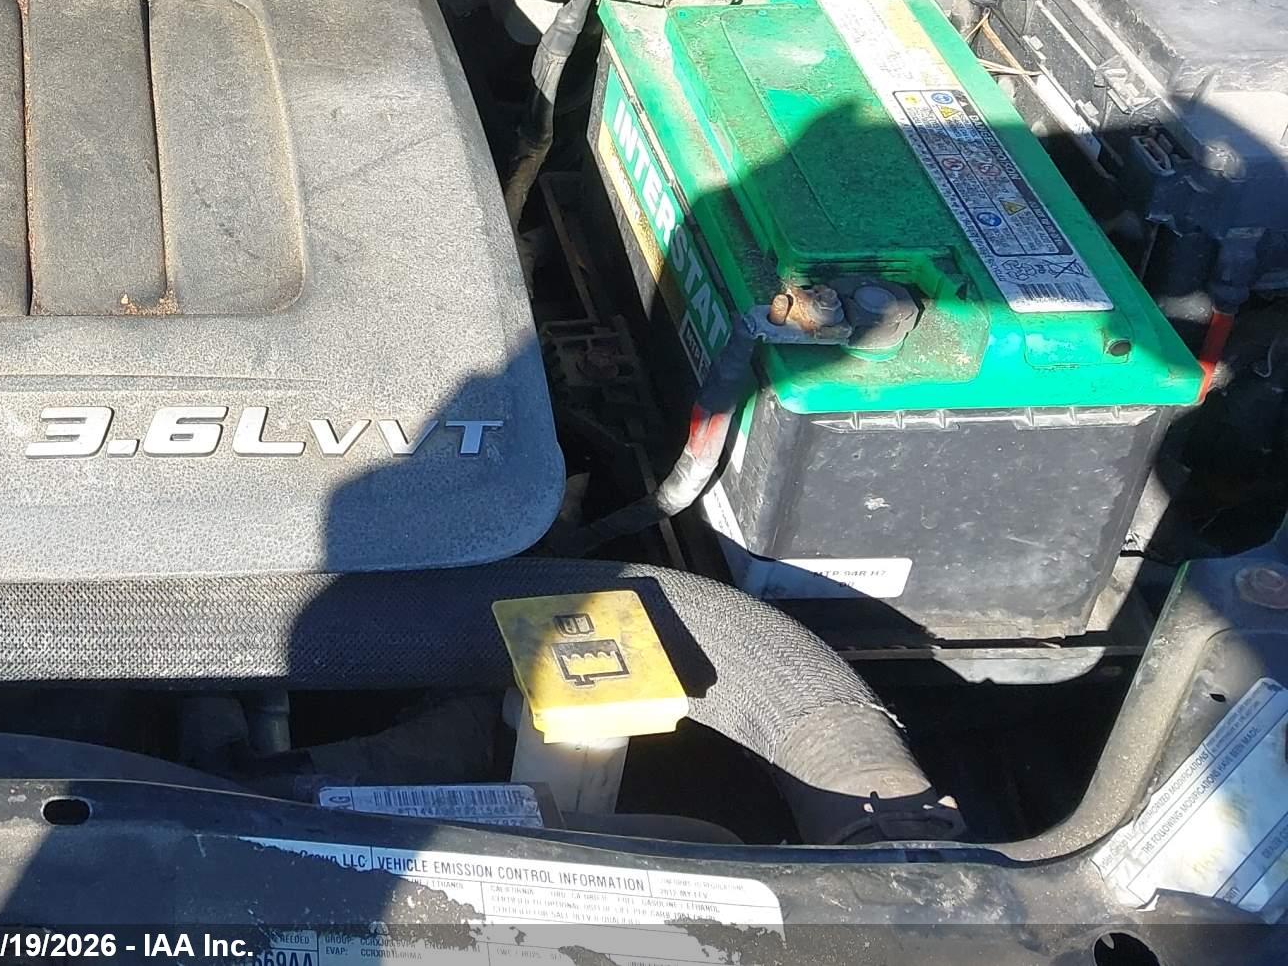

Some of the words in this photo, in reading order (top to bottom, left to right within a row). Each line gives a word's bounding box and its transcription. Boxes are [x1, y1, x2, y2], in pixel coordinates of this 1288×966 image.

[613, 97, 730, 348] INTERSTAT
[25, 406, 306, 458] 3.6L
[312, 418, 504, 458] VVT
[1141, 840, 1155, 854] THE
[1151, 809, 1184, 846] FOLLOWING
[342, 853, 367, 868] LLC
[377, 856, 429, 873] VEHICLE
[434, 861, 493, 878] EMISSION
[498, 866, 555, 884] CONTROL
[559, 872, 645, 892] INFORMATION
